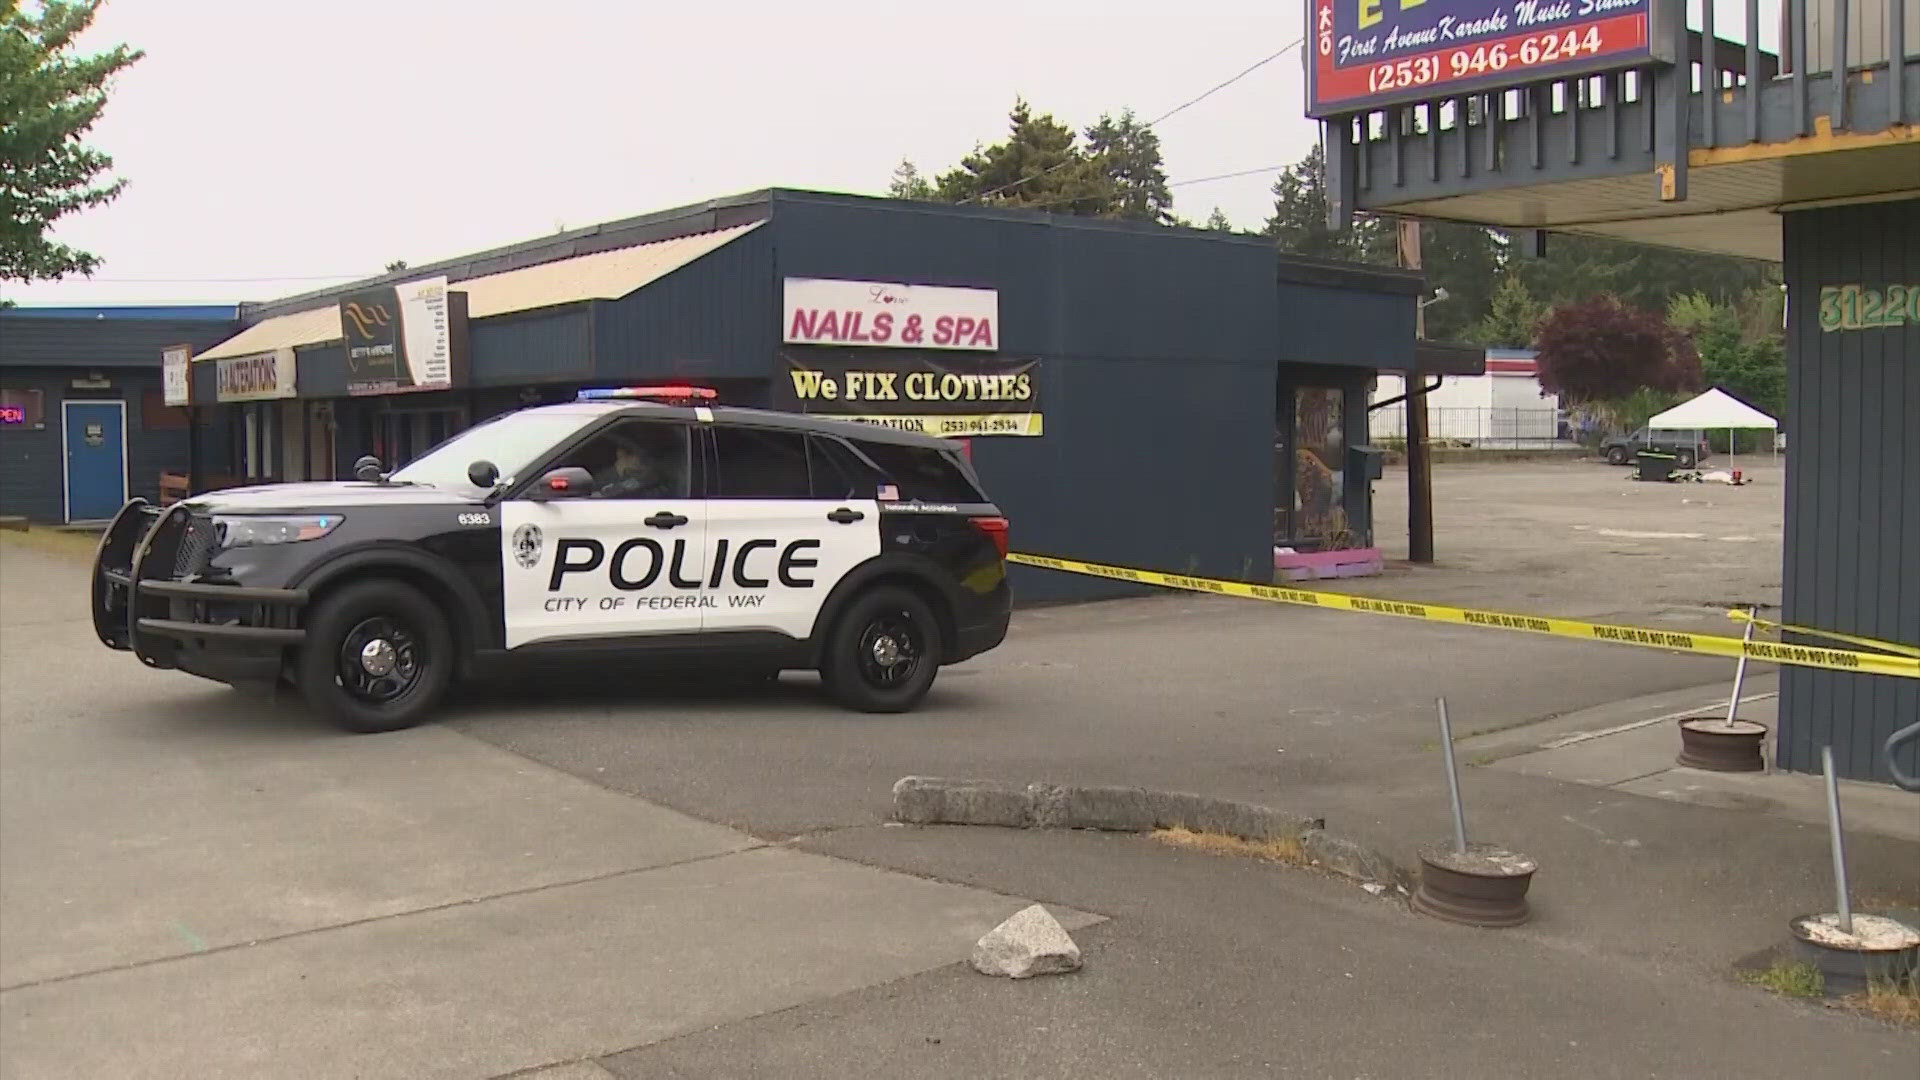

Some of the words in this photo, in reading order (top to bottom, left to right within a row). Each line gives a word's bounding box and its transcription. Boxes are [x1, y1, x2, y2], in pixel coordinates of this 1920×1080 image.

[1338, 35, 1378, 64] First
[1382, 26, 1437, 53] Avenue
[1438, 8, 1508, 41] Karaoke
[1515, 0, 1571, 26] Music
[1369, 55, 1440, 93] (253)
[1450, 26, 1602, 77] 946-6244
[789, 308, 894, 342] NAILS
[901, 313, 924, 344] &
[932, 316, 993, 346] SPA
[790, 370, 838, 401] We
[844, 372, 898, 401] FIX
[904, 372, 1032, 401] CLOTHES
[0, 408, 22, 422] PEN
[940, 420, 968, 433] (253)
[458, 513, 490, 525] 6383
[548, 538, 821, 591] POLICE
[544, 597, 588, 612] CITY
[599, 597, 625, 610] OF
[636, 596, 719, 609] FEDERAL
[728, 595, 766, 608] WAY
[1350, 599, 1369, 610] POLICE
[1370, 601, 1383, 611] LINE
[1384, 603, 1392, 612] DO
[1394, 604, 1404, 614] NOT
[1406, 605, 1425, 616] CROSS
[1464, 611, 1486, 624] POLICE
[1487, 614, 1500, 625] LINE
[1502, 616, 1512, 627] DO
[1513, 617, 1525, 628] NOT
[1527, 619, 1550, 631] CROSS
[1593, 626, 1620, 640] POLICE
[1620, 629, 1637, 641] LINE
[1638, 631, 1649, 643] DO
[1650, 632, 1665, 645] NOT
[1666, 634, 1693, 648] CROSS
[1744, 642, 1772, 657] POLICE
[1774, 645, 1793, 660] LINE
[1794, 648, 1807, 661] DO
[1809, 650, 1826, 664] NOT
[1828, 652, 1859, 667] CROSS
